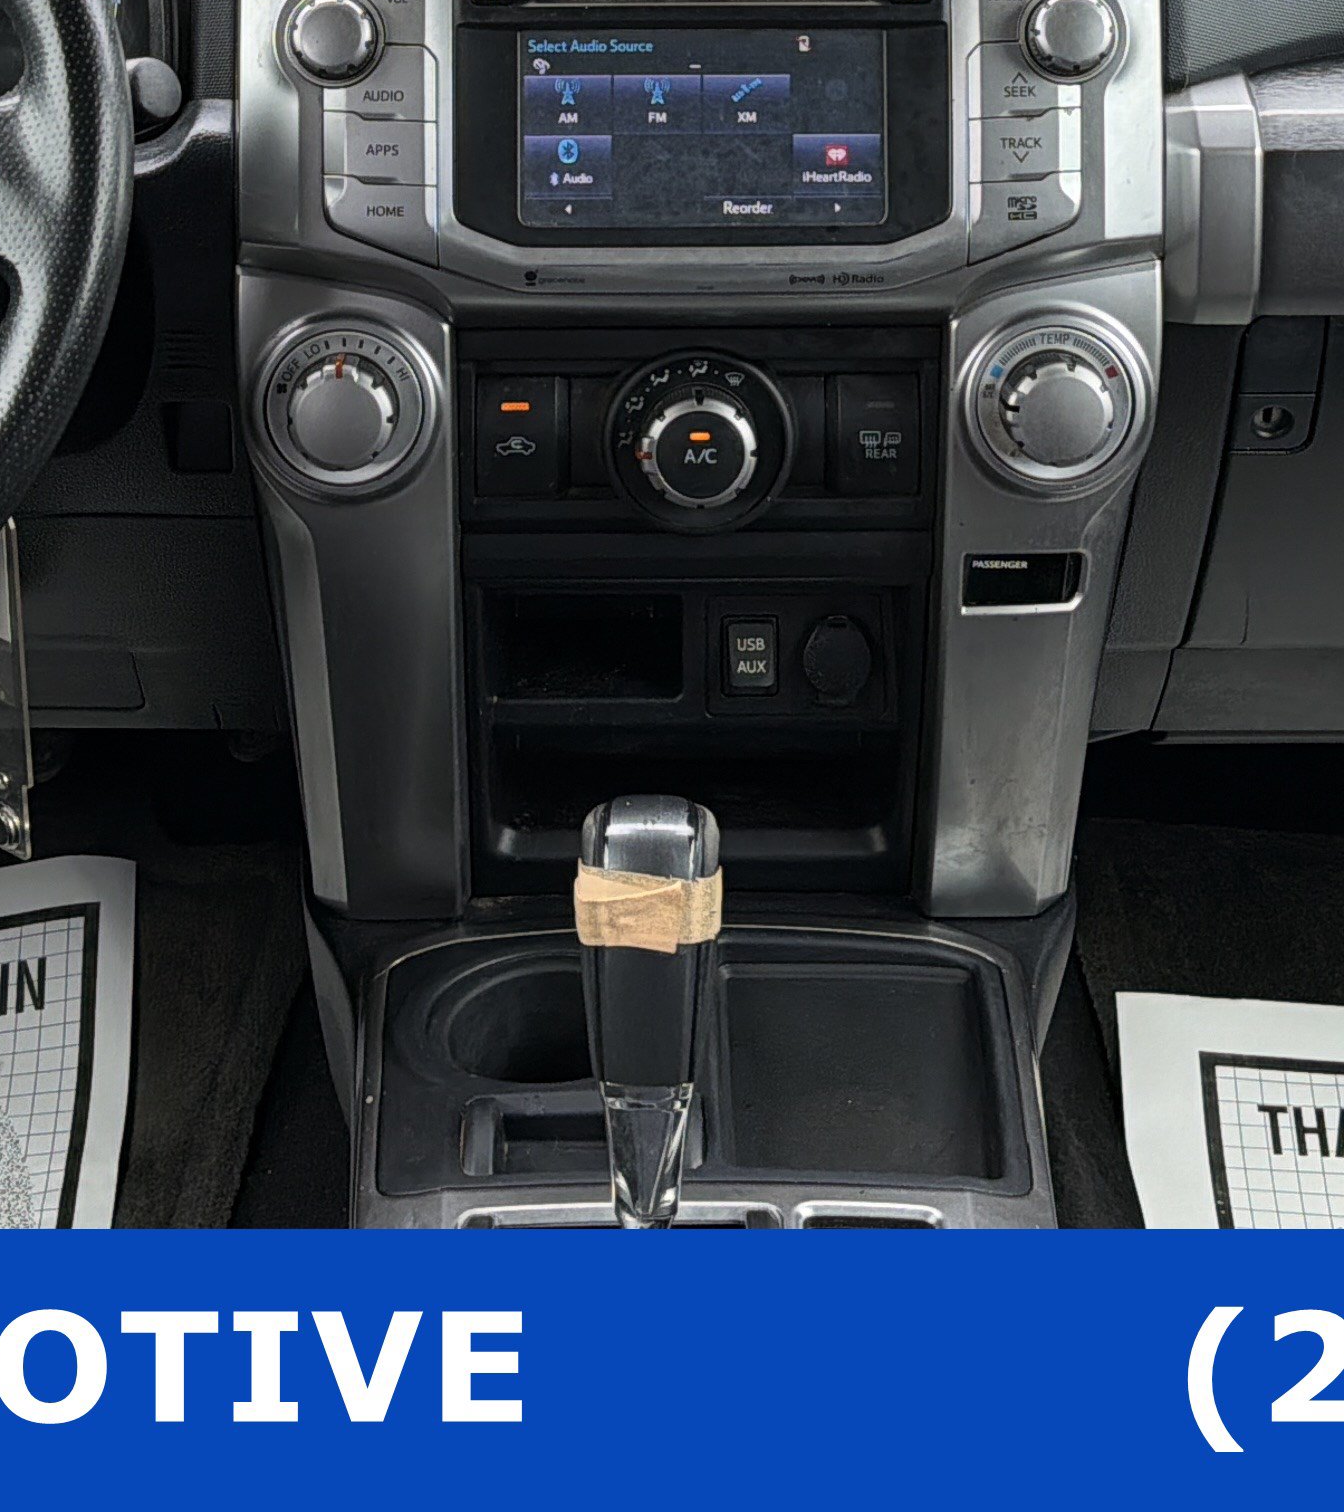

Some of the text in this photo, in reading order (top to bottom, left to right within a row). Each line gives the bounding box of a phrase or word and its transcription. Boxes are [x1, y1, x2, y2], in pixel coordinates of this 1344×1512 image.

[527, 39, 654, 54] Select Audio Source
[362, 89, 405, 103] AUDIO
[1003, 85, 1037, 99] SEEK
[558, 112, 579, 124] AM
[648, 112, 667, 124] FM
[737, 111, 757, 123] XM
[1000, 137, 1043, 149] TRACK
[365, 144, 400, 157] APPS
[562, 172, 594, 185] Audio
[802, 171, 873, 183] iHeartRadio
[366, 205, 405, 218] HOME
[723, 200, 774, 215] Reorder
[851, 273, 885, 283] Radio
[1039, 332, 1071, 345] TEMP
[303, 343, 321, 360] LO
[281, 358, 302, 381] OFF
[395, 367, 410, 381] HI
[684, 448, 718, 464] A/C
[865, 448, 897, 460] REAR
[972, 559, 1028, 570] PASSENGER
[736, 637, 766, 651] USB
[736, 660, 767, 674] AUX
